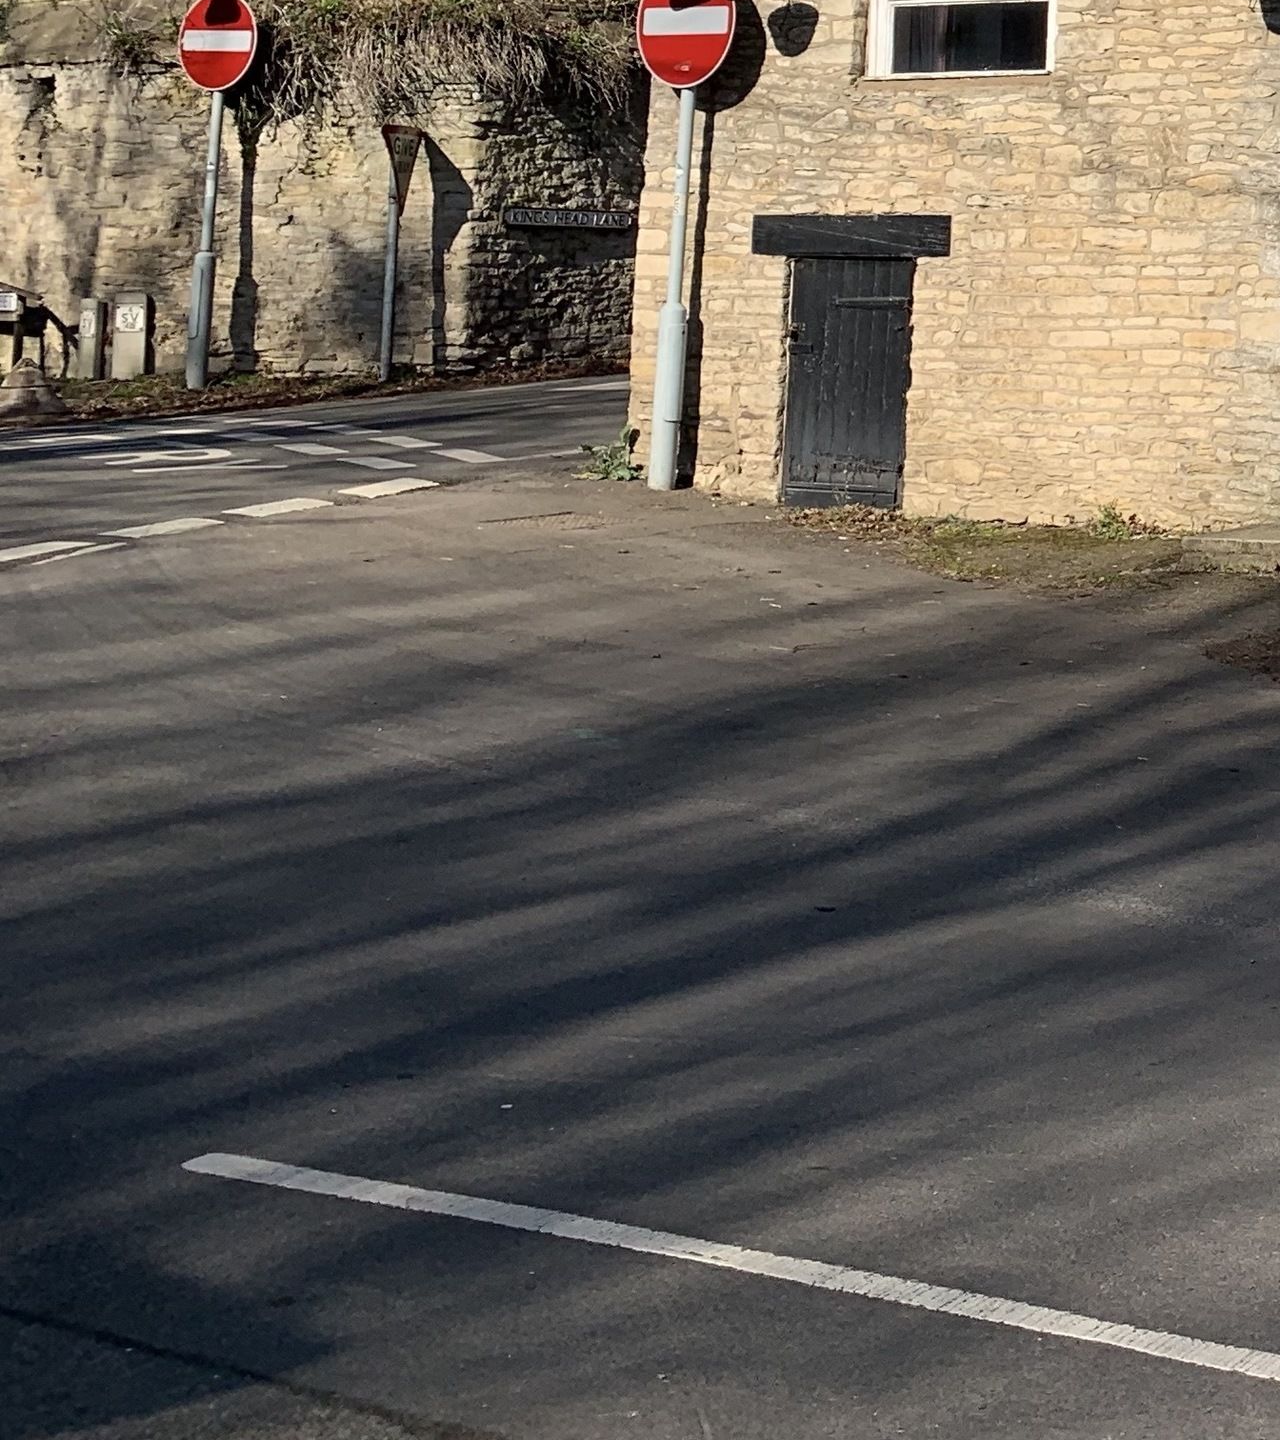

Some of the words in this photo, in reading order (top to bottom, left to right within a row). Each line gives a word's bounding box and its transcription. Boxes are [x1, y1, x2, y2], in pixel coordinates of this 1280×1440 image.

[511, 210, 550, 224] KINGS
[554, 211, 589, 225] HEAD
[593, 213, 626, 227] LANE
